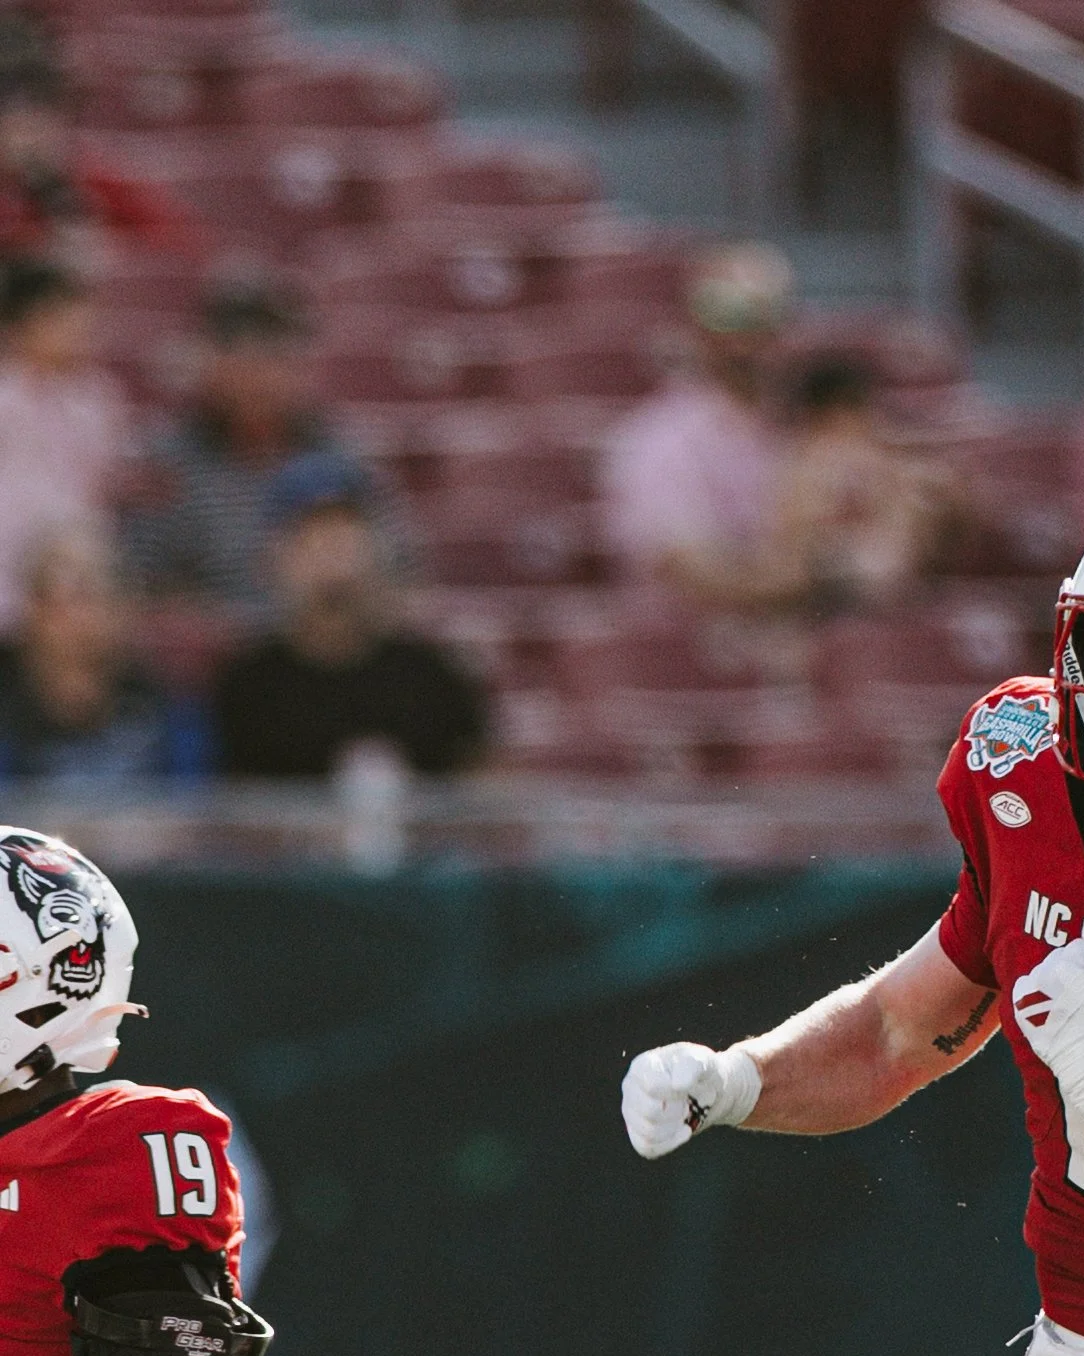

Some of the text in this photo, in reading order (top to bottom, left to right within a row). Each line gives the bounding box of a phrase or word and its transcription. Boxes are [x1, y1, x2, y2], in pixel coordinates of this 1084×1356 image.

[997, 800, 1025, 818] ACC
[1024, 890, 1072, 947] NC
[141, 1132, 218, 1217] 19
